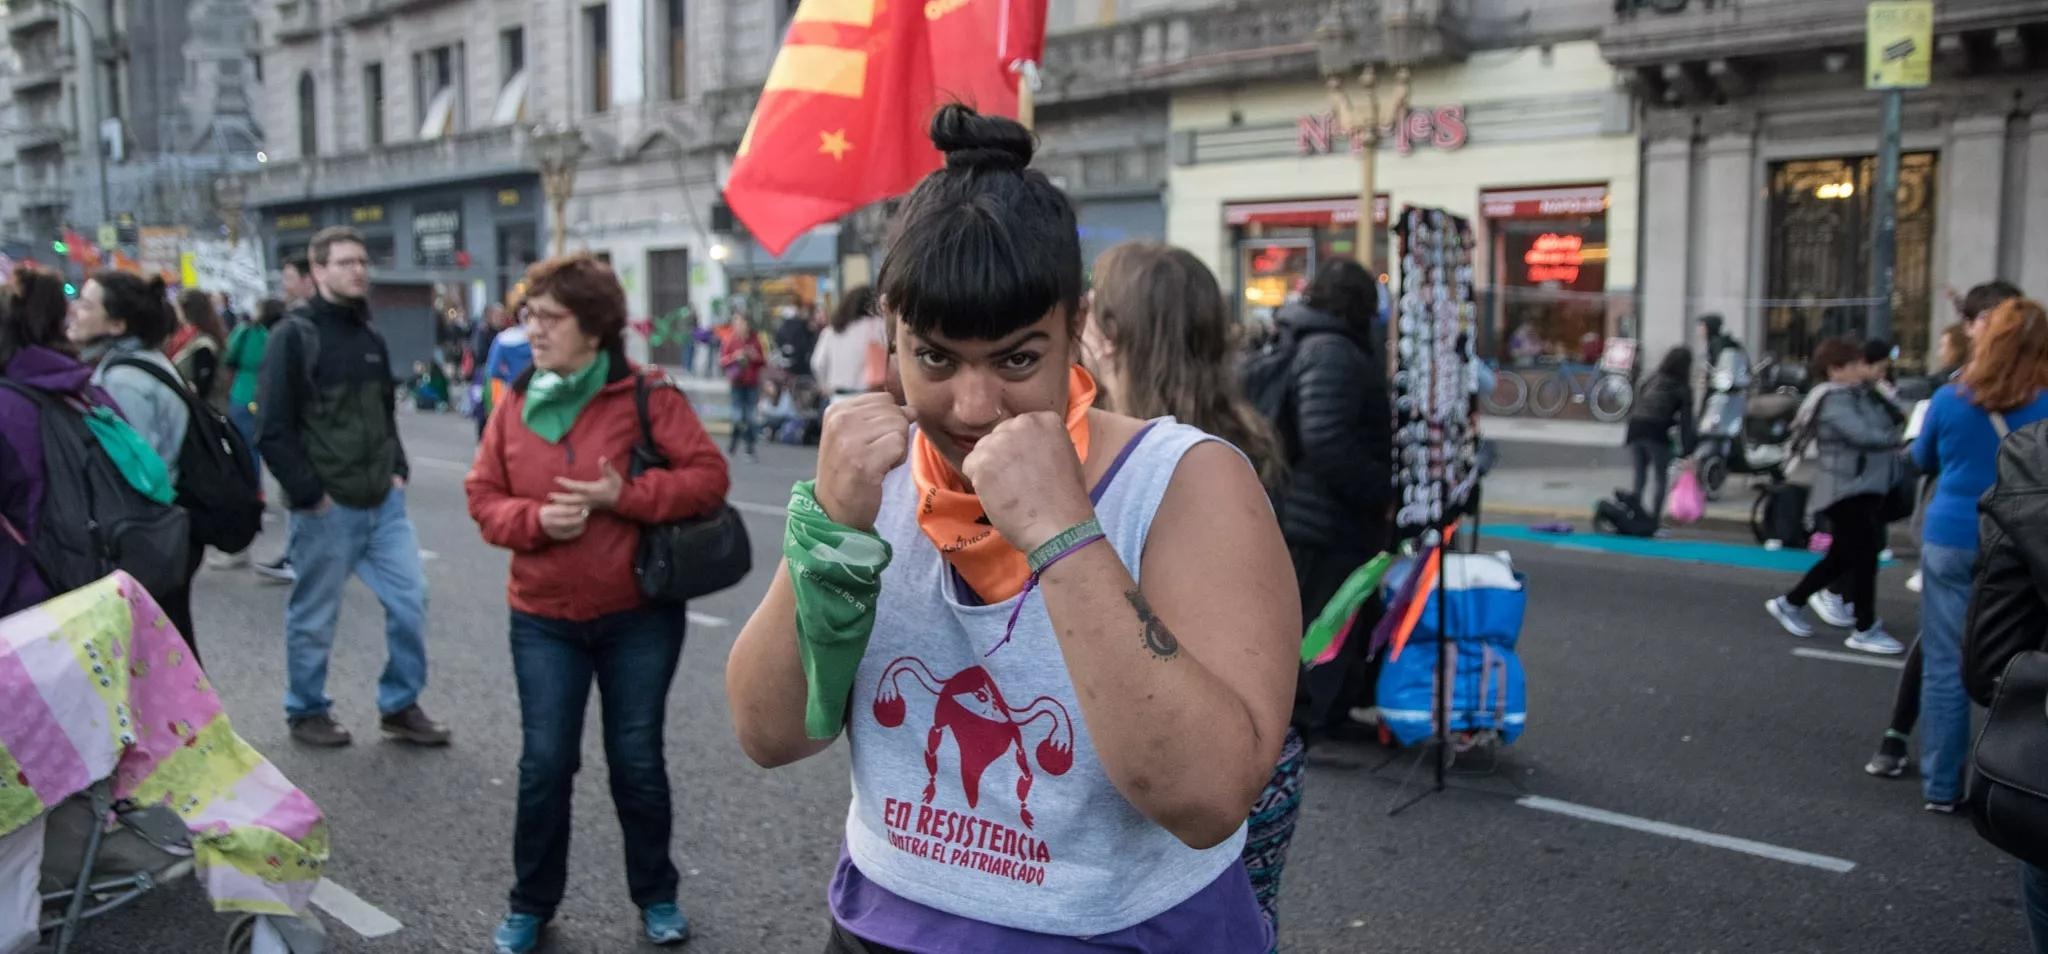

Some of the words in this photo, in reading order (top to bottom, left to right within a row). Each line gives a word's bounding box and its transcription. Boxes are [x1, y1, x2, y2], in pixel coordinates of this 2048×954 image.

[884, 797, 912, 831] EN
[916, 804, 1051, 863] RESISTENCIA
[887, 829, 928, 858] CONTRA
[931, 842, 946, 864] EL
[950, 849, 1045, 887] PATRIARCADO
